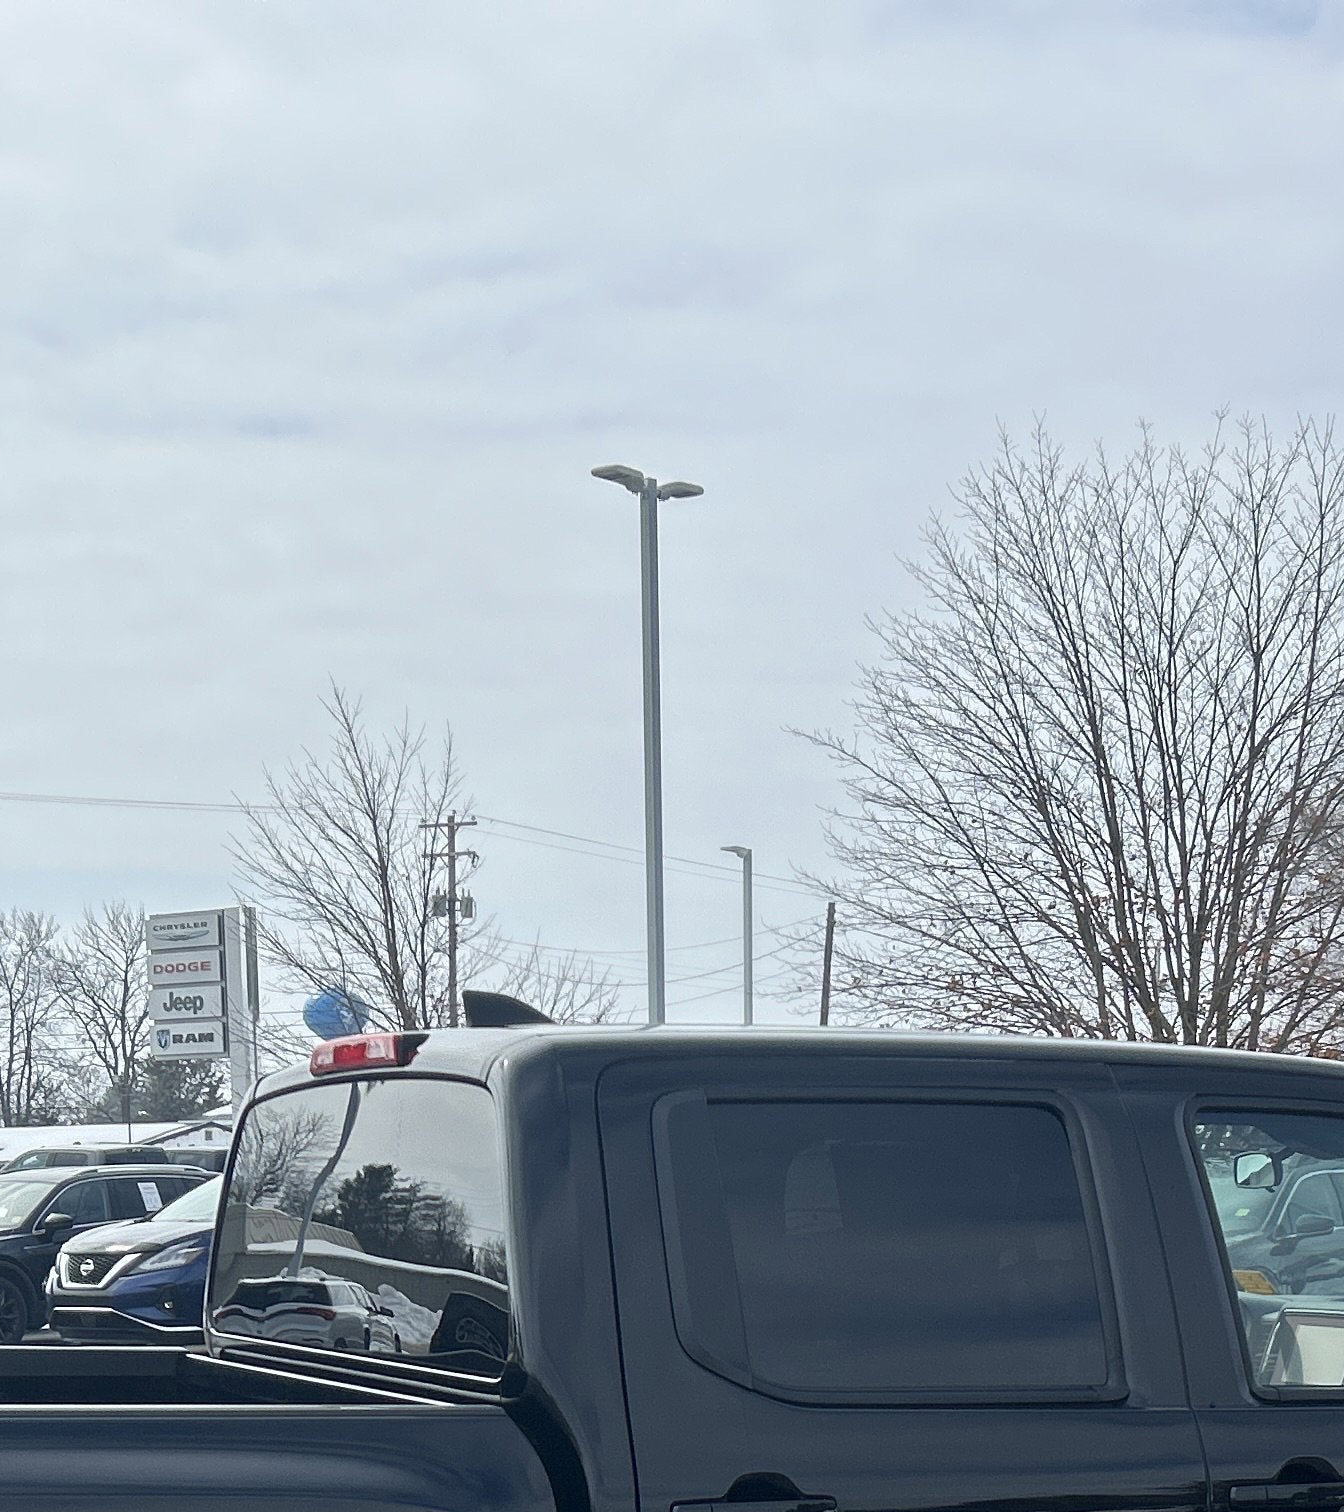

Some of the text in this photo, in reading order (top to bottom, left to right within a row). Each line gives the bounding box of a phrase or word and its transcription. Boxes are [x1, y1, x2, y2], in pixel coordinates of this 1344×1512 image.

[152, 921, 208, 932] CHRYSLER
[153, 961, 212, 975] DODGE
[162, 991, 204, 1015] Jeep
[172, 1032, 215, 1044] RAM
